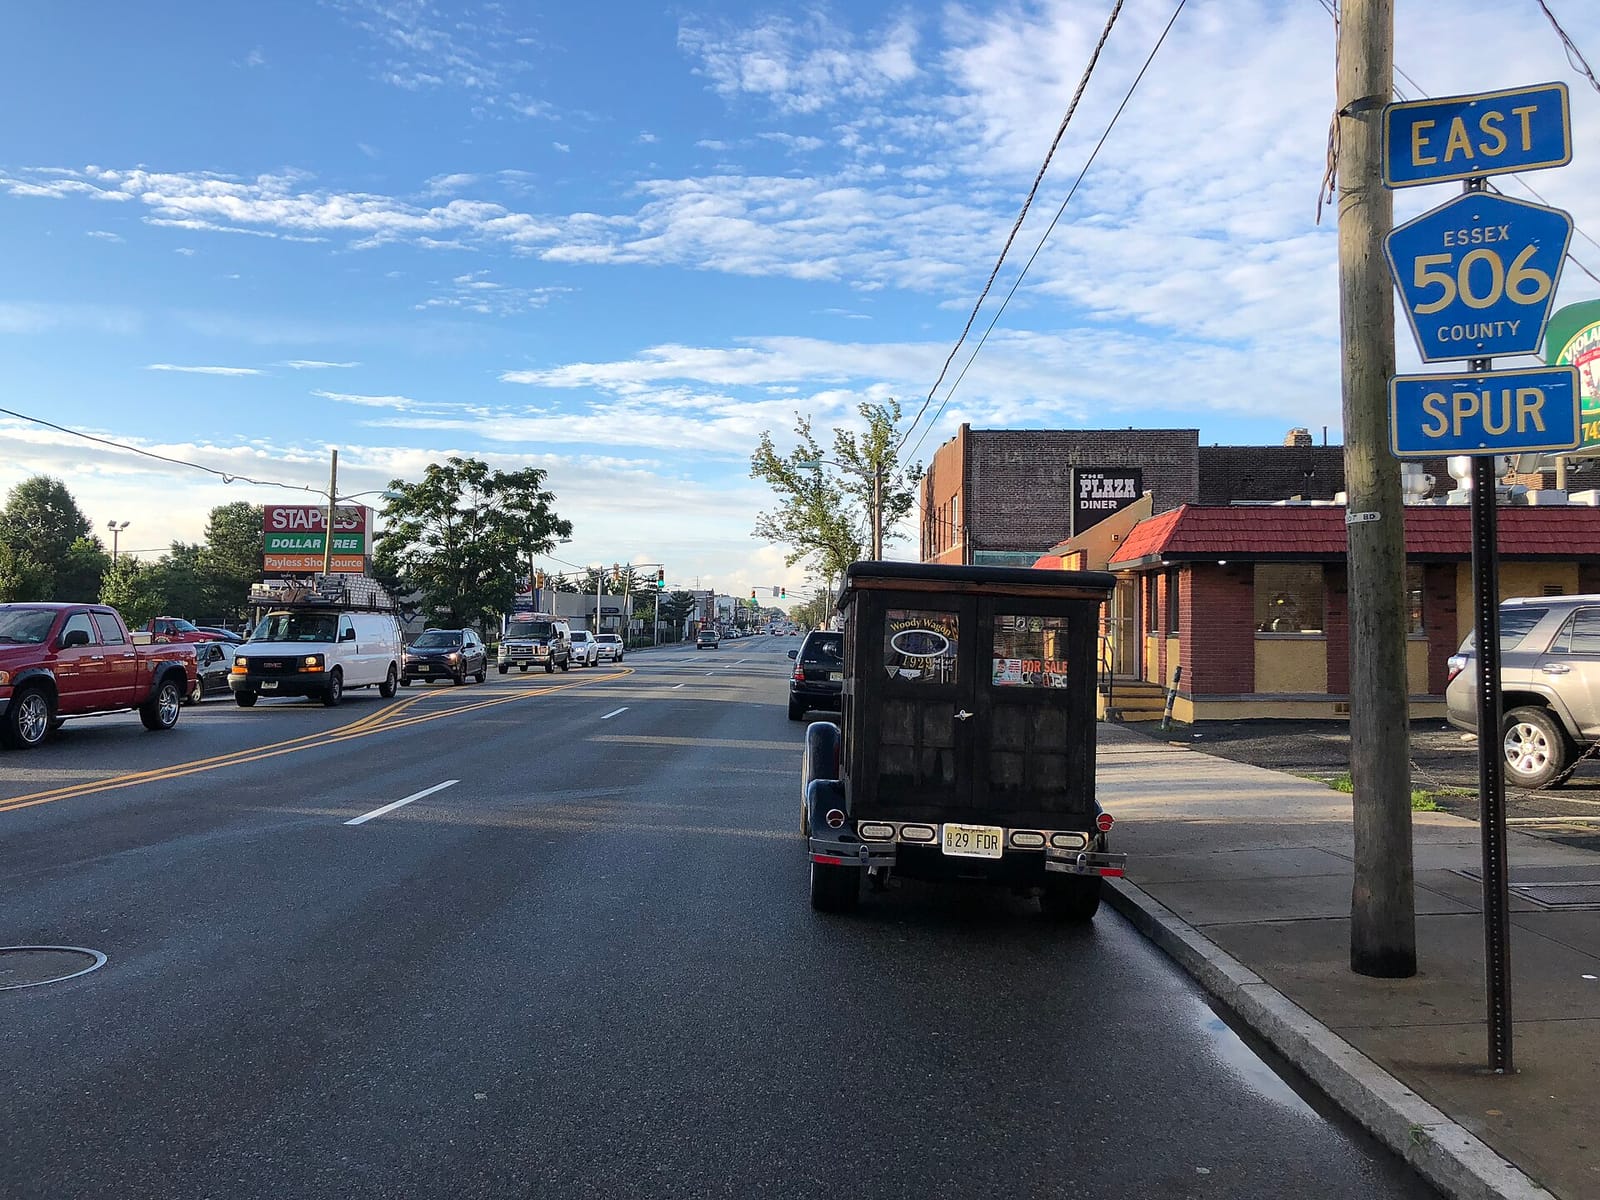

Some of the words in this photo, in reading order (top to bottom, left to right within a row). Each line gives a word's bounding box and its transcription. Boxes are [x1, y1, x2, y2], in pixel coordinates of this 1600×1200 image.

[1412, 105, 1538, 167] EAST
[1443, 224, 1511, 247] ESSEX
[1413, 244, 1552, 314] 506
[1437, 319, 1521, 342] COUNTY
[1564, 326, 1600, 362] VIOLA
[1421, 387, 1546, 438] SPUR
[1581, 420, 1600, 442] 74
[1080, 479, 1136, 498] PLAZA
[1080, 500, 1117, 509] DINER
[271, 538, 322, 549] DOLLAR
[332, 539, 358, 549] REE
[265, 557, 302, 569] Payless
[890, 618, 920, 631] Woody
[923, 618, 952, 636] Wagon
[902, 655, 933, 669] 1929
[1022, 660, 1041, 673] FOR
[1044, 660, 1068, 673] SALE
[955, 832, 969, 848] 29
[976, 834, 998, 850] FDR
